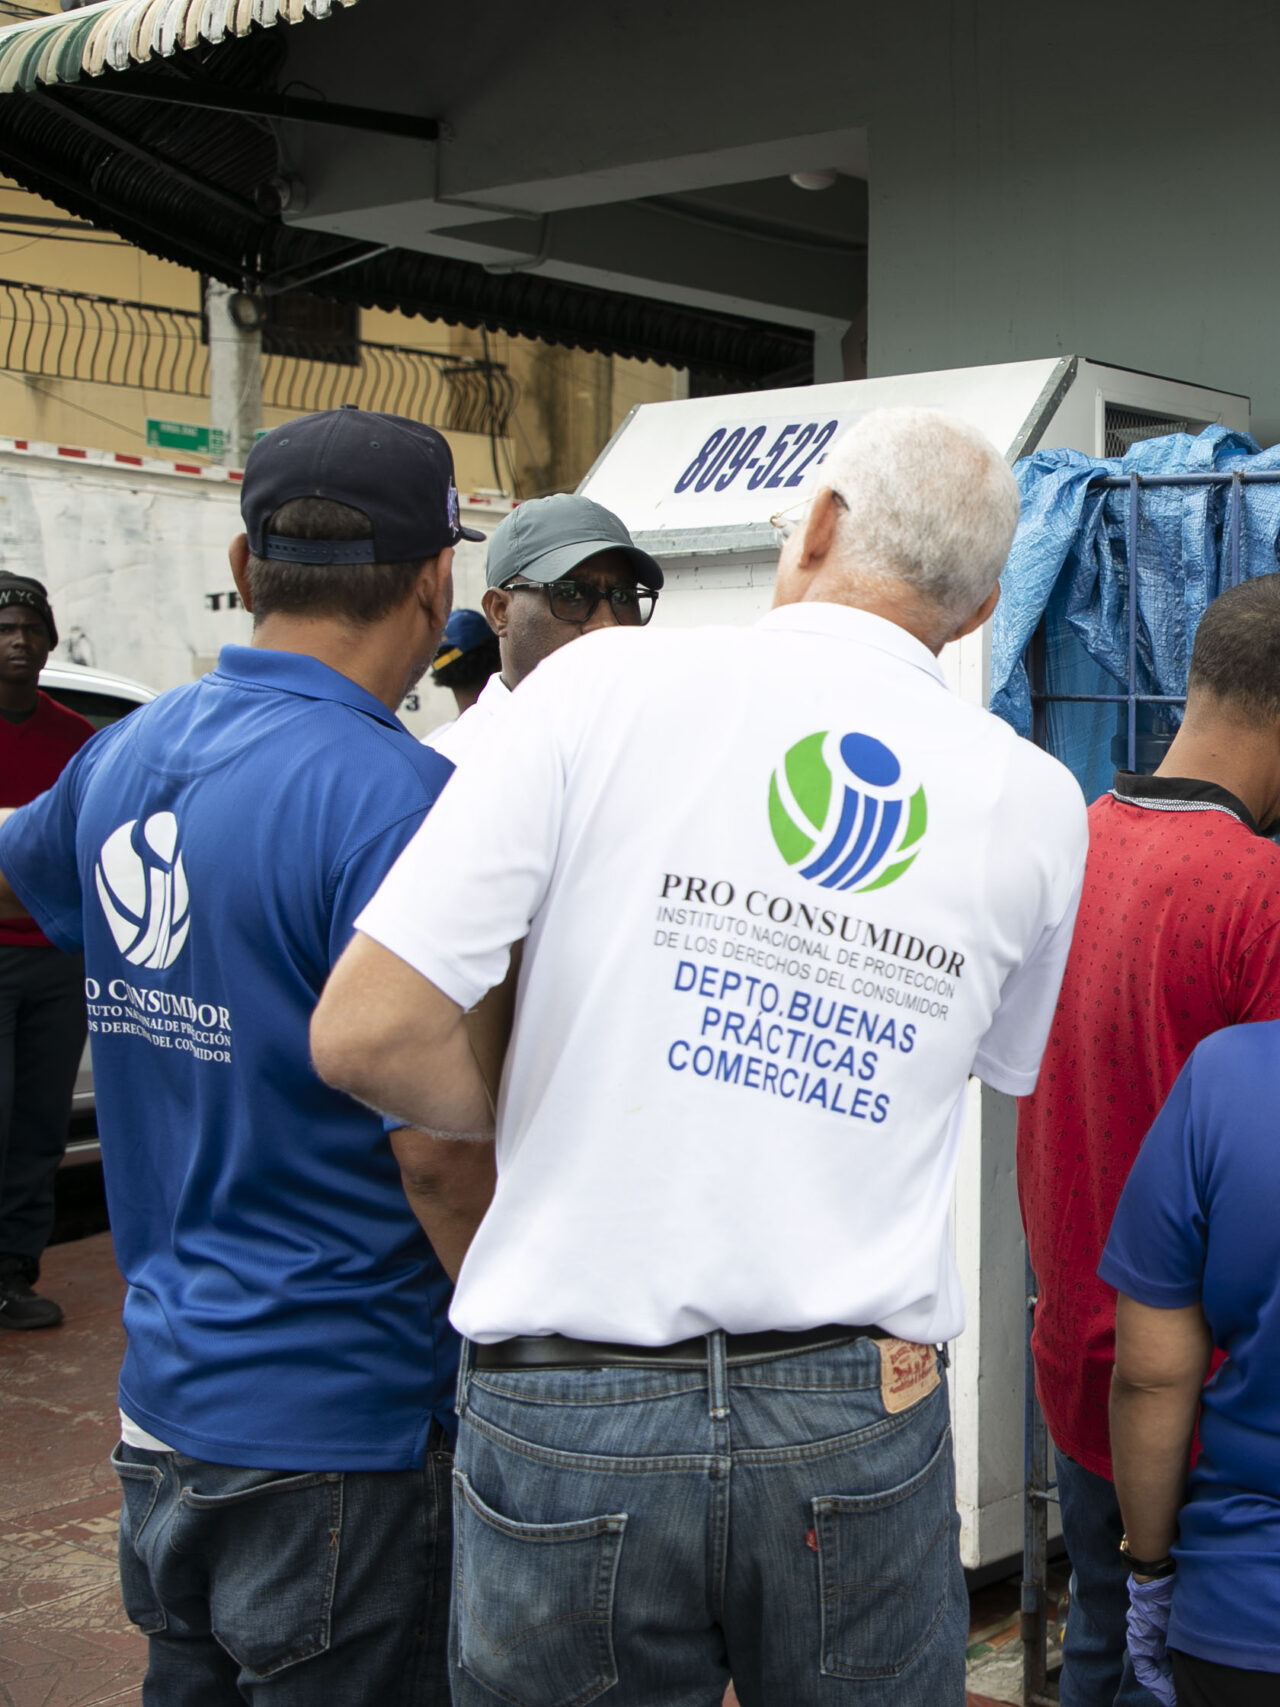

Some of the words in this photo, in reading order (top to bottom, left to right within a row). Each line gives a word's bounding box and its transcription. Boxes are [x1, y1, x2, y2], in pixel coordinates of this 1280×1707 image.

[656, 906, 747, 936] INSTITUTO
[751, 920, 831, 961] NACIONAL
[836, 948, 859, 969] DE
[863, 956, 955, 998] PROTECCIÓN
[659, 873, 735, 908] PRO
[746, 891, 965, 977] CONSUMIDOR
[108, 979, 232, 1031] CONSUMIDOR
[654, 930, 677, 947] DE
[684, 935, 717, 954] LOS
[722, 941, 811, 979] DERECHOS
[815, 966, 846, 990] DEL
[852, 978, 949, 1021] CONSUMIDOR
[101, 1021, 152, 1043] DEREC
[152, 1035, 173, 1048] DEL
[175, 1038, 231, 1064] CONMIDOR
[124, 1006, 163, 1030] NANAL
[165, 1020, 179, 1033] DE
[701, 1006, 879, 1081] PRÁCTICAS
[668, 1040, 890, 1123] COMERCIALES
